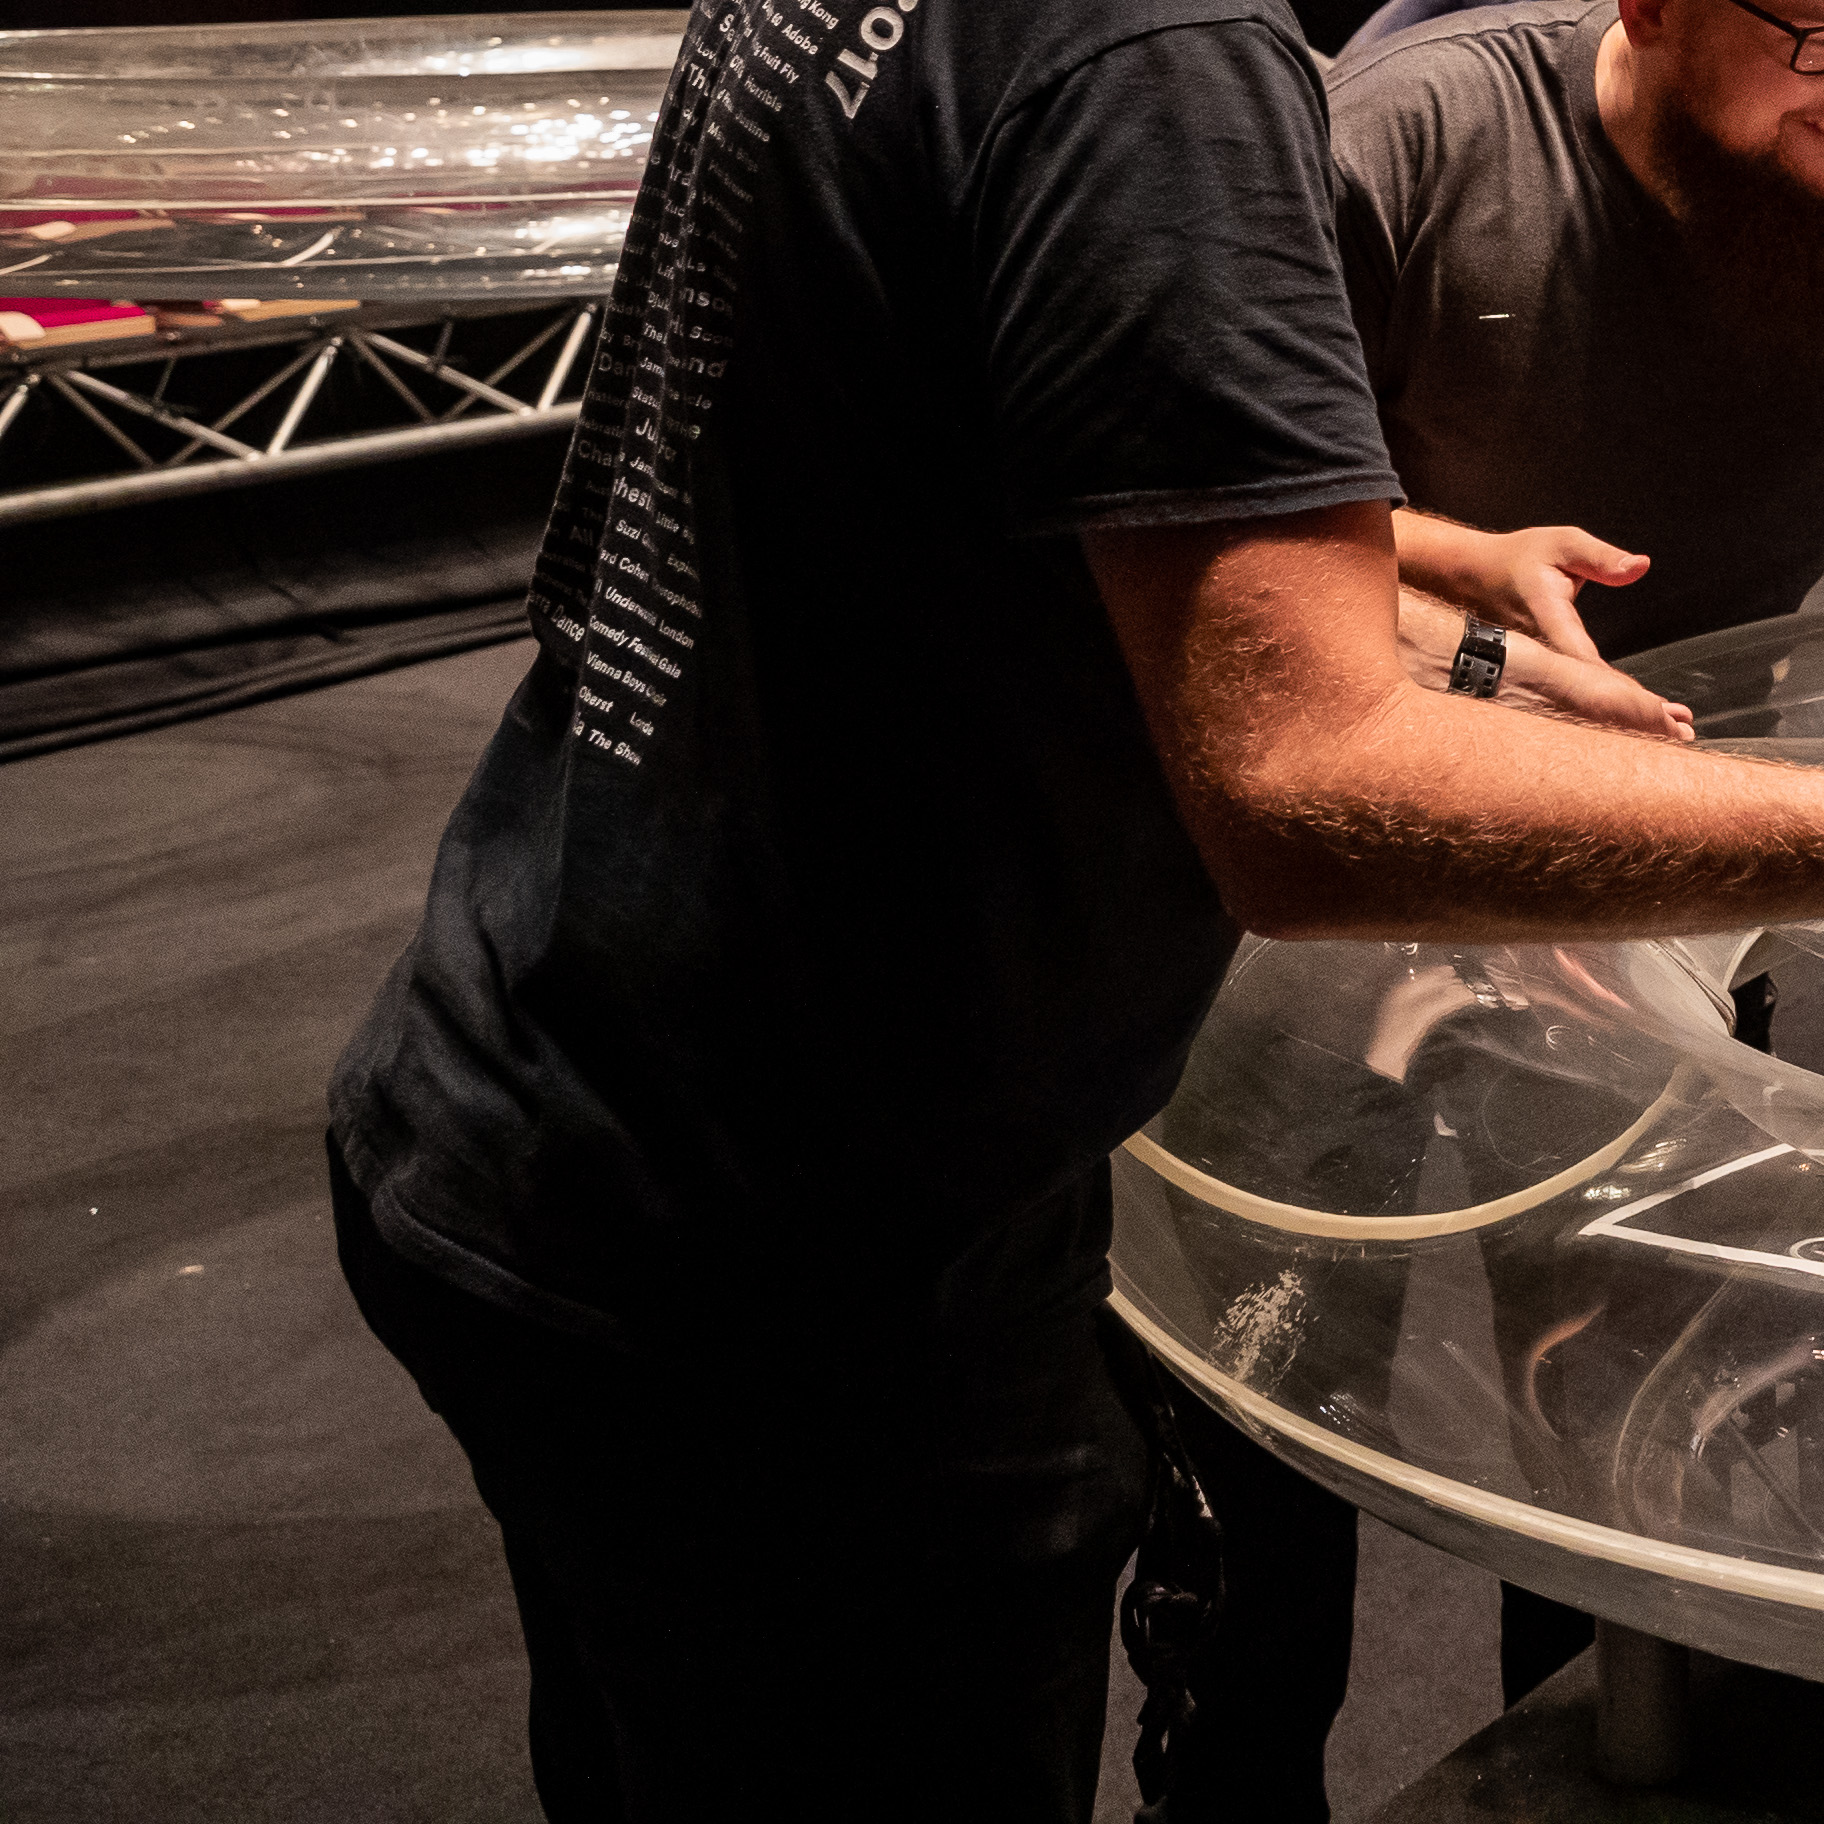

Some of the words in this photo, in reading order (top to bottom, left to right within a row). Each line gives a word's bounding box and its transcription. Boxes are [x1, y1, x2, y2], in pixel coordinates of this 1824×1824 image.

[808, 1, 840, 29] Kong
[782, 23, 819, 55] Adobe
[779, 62, 800, 84] Fly
[744, 76, 783, 112] Horrible
[589, 615, 630, 647] Comedy
[658, 657, 682, 679] Gala
[658, 620, 695, 650] London
[586, 651, 623, 680] Vienna
[622, 670, 647, 693] Boys
[579, 685, 614, 712] Oberst
[588, 728, 613, 750] The
